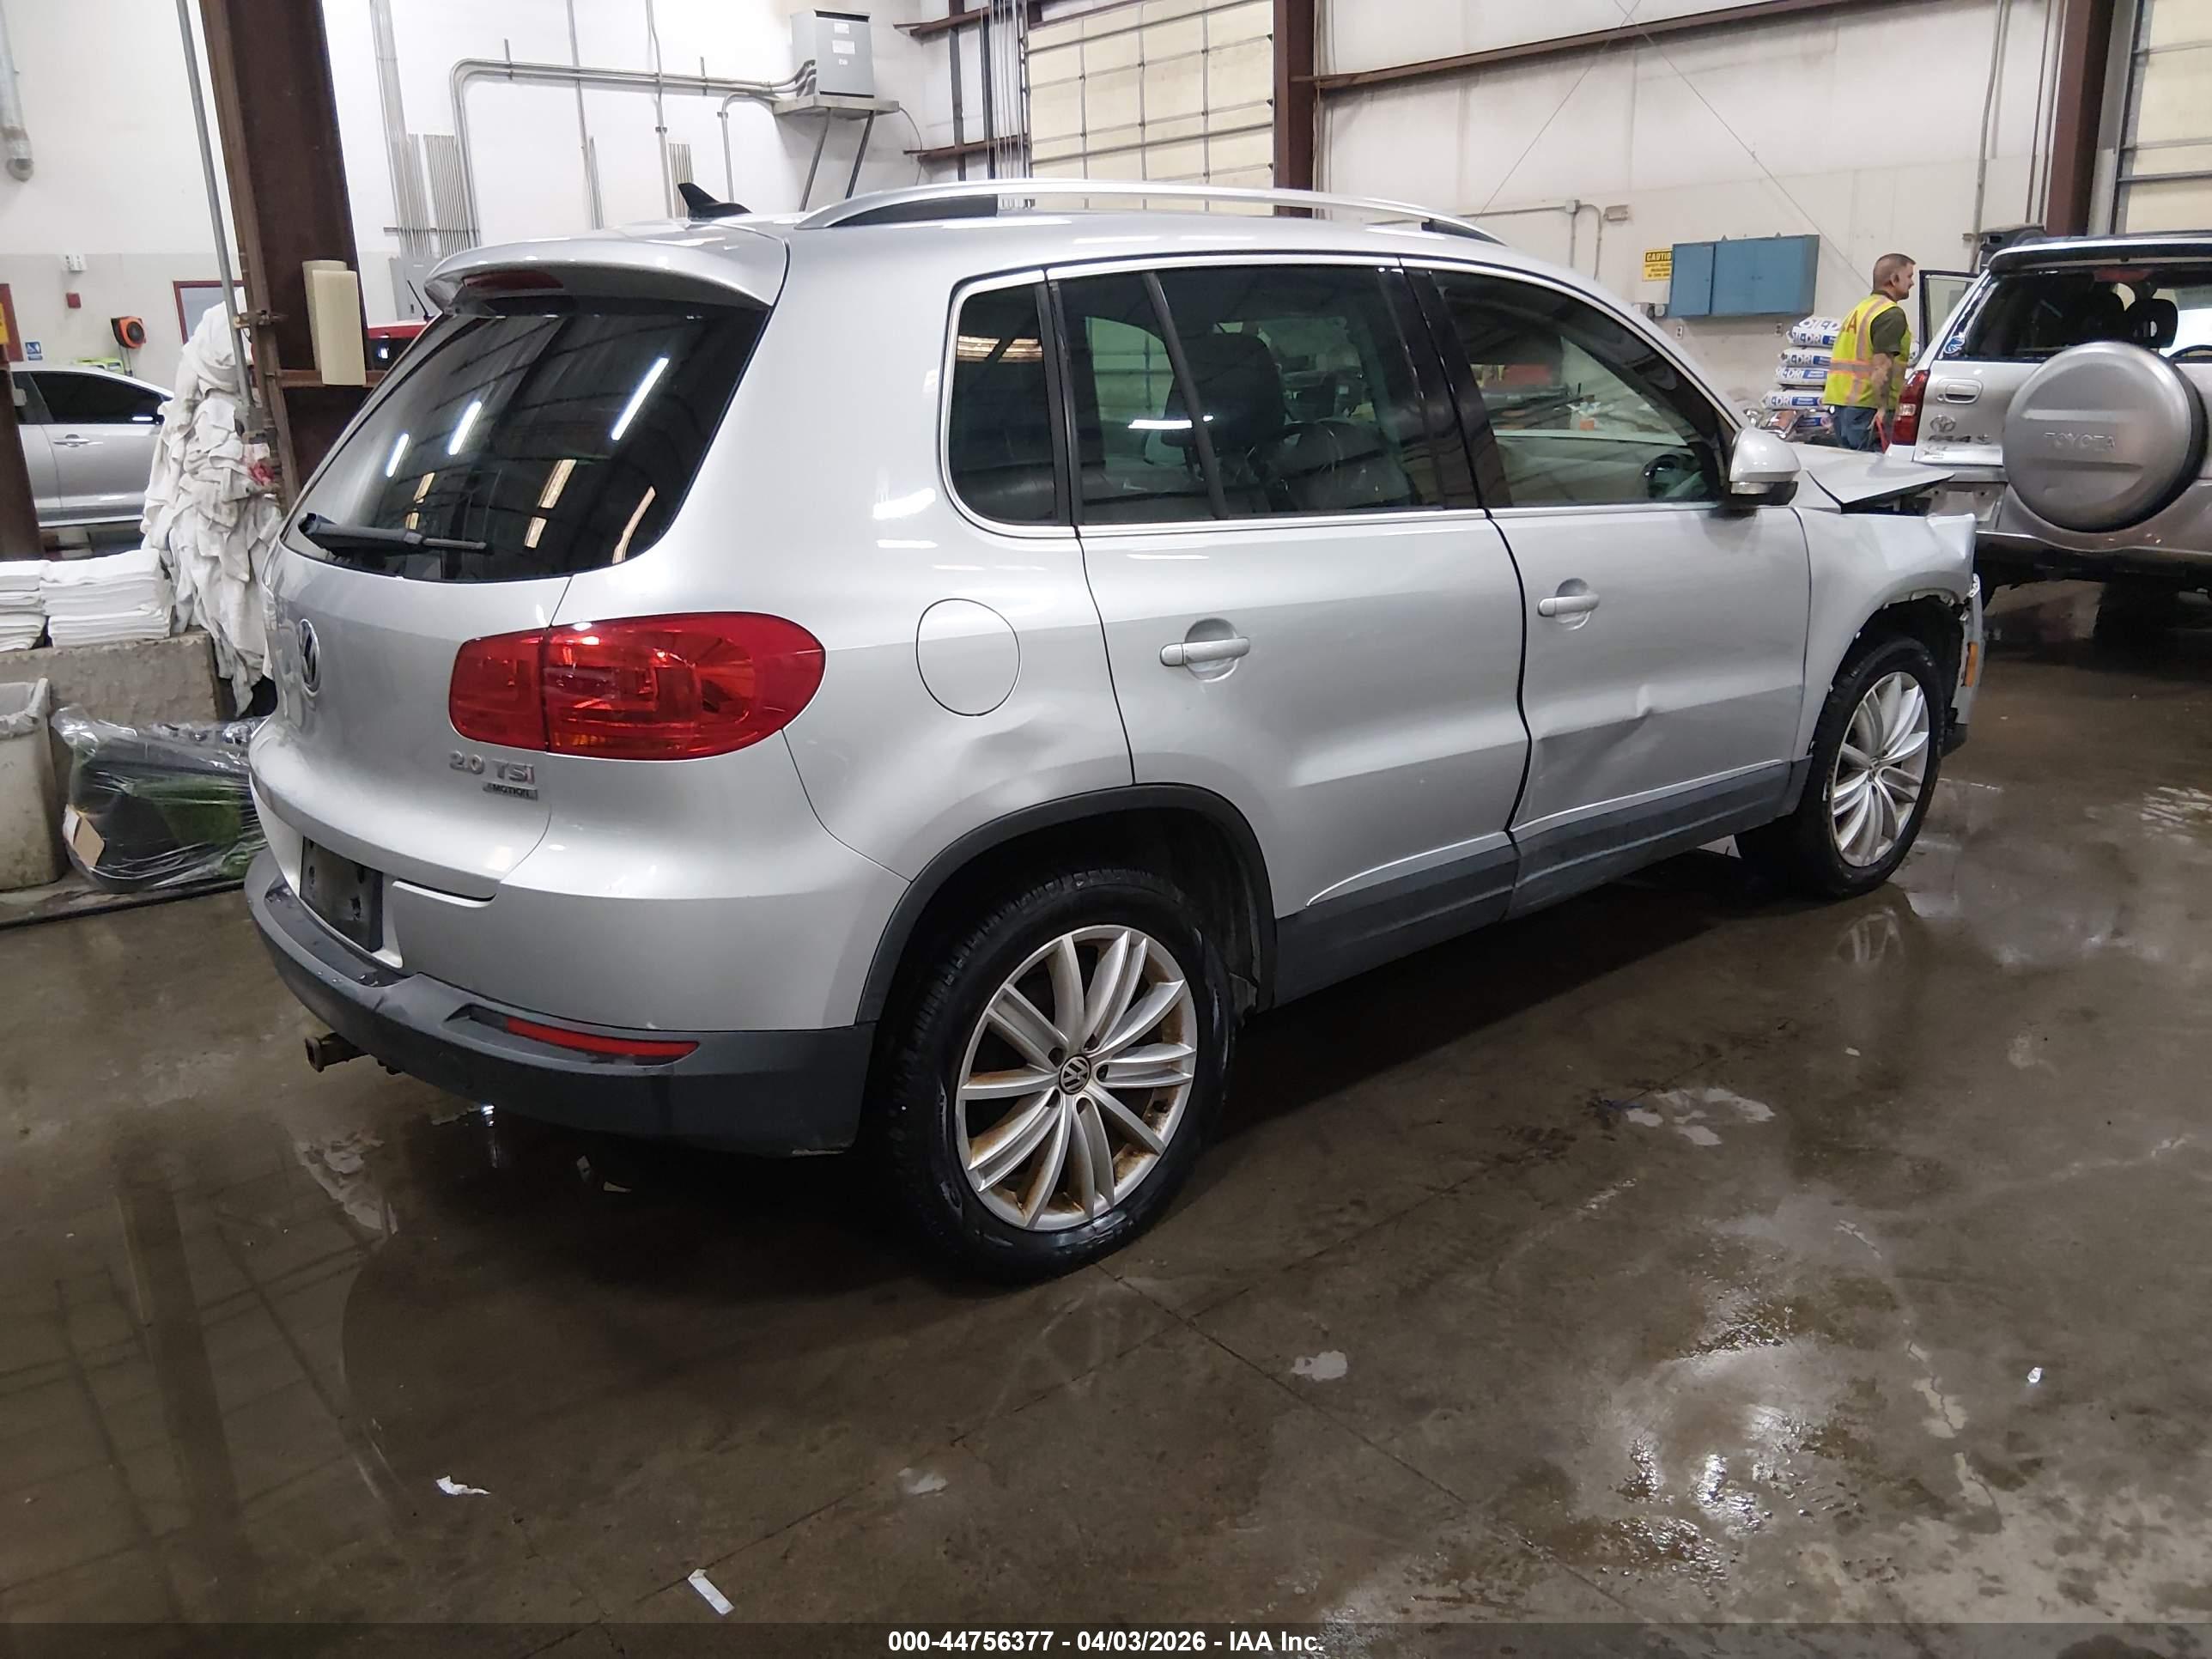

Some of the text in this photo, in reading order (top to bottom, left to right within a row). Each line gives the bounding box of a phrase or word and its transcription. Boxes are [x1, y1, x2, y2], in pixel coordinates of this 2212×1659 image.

[1646, 252, 1672, 261] CAUTIO
[2044, 432, 2116, 451] TOYOTA
[491, 758, 535, 785] TSI
